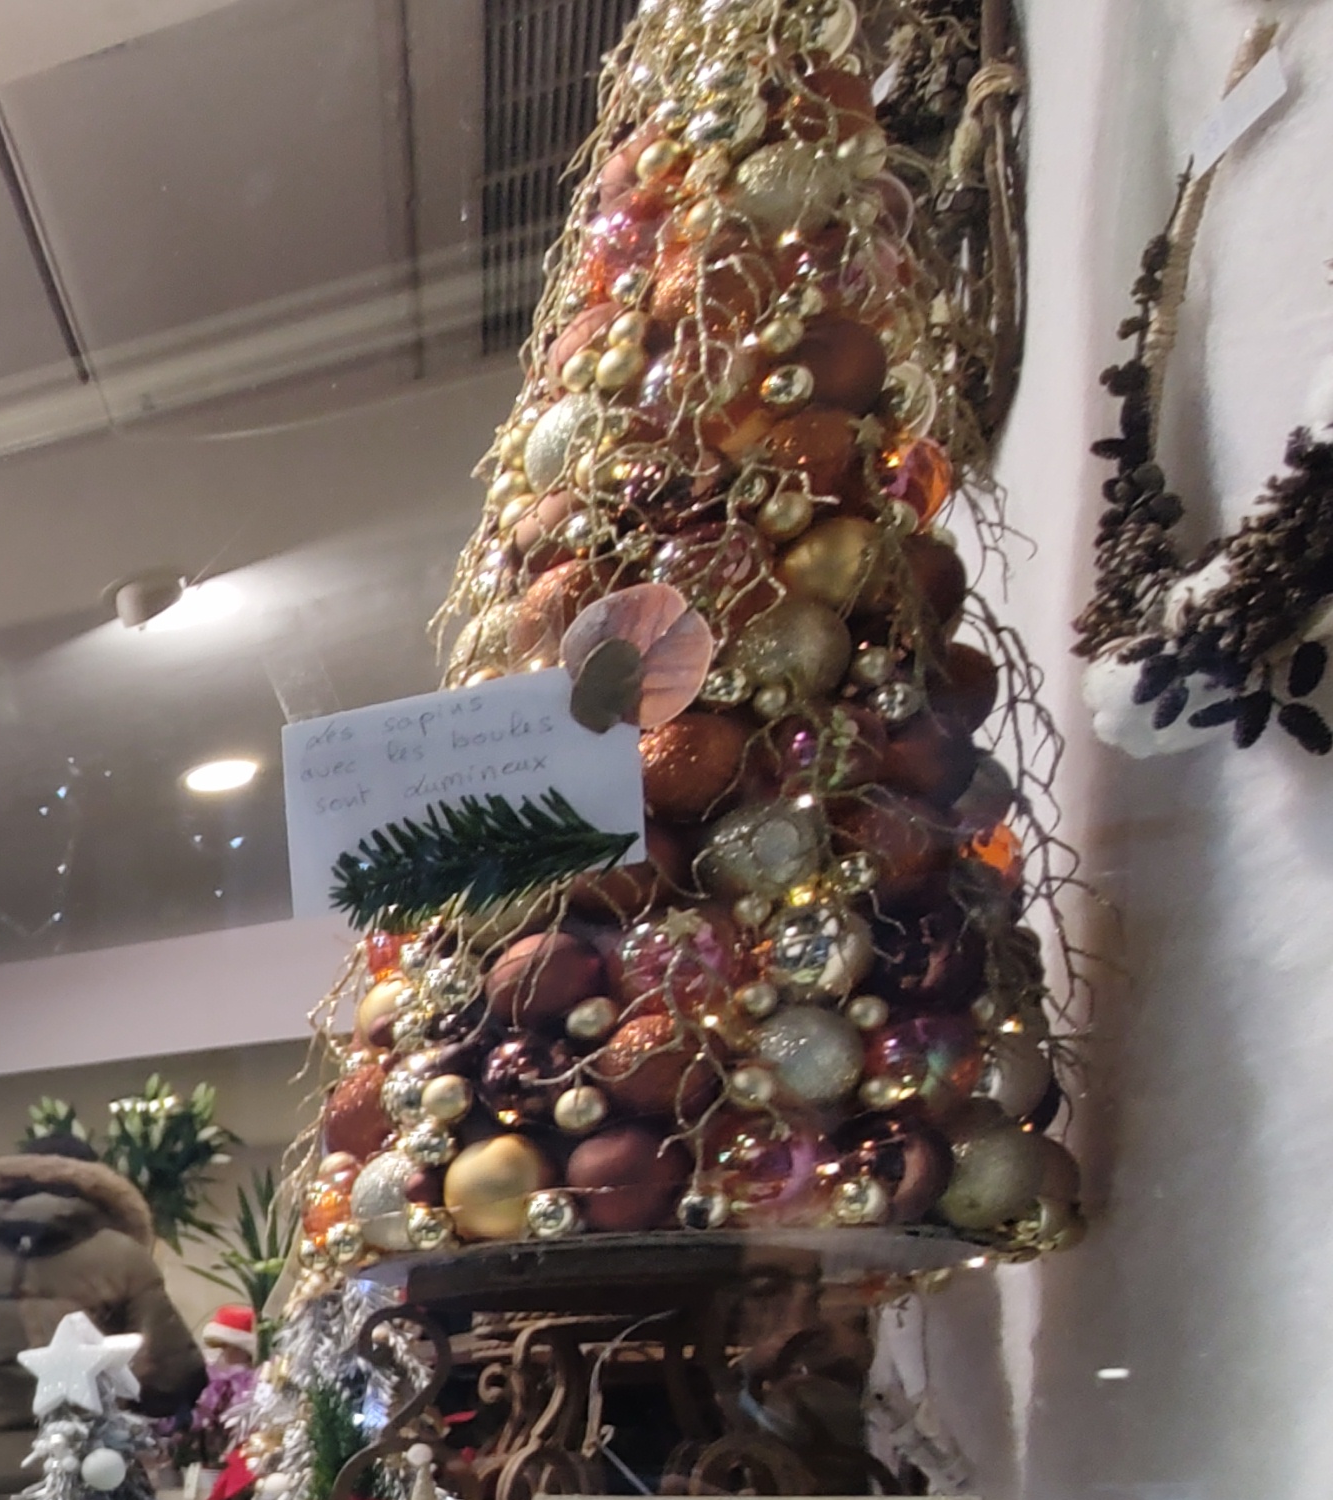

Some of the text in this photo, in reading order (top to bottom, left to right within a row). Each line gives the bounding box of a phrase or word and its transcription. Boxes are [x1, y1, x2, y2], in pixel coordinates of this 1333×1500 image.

[383, 695, 483, 736] sapins
[300, 712, 554, 783] avec les boules
[315, 787, 369, 815] sont
